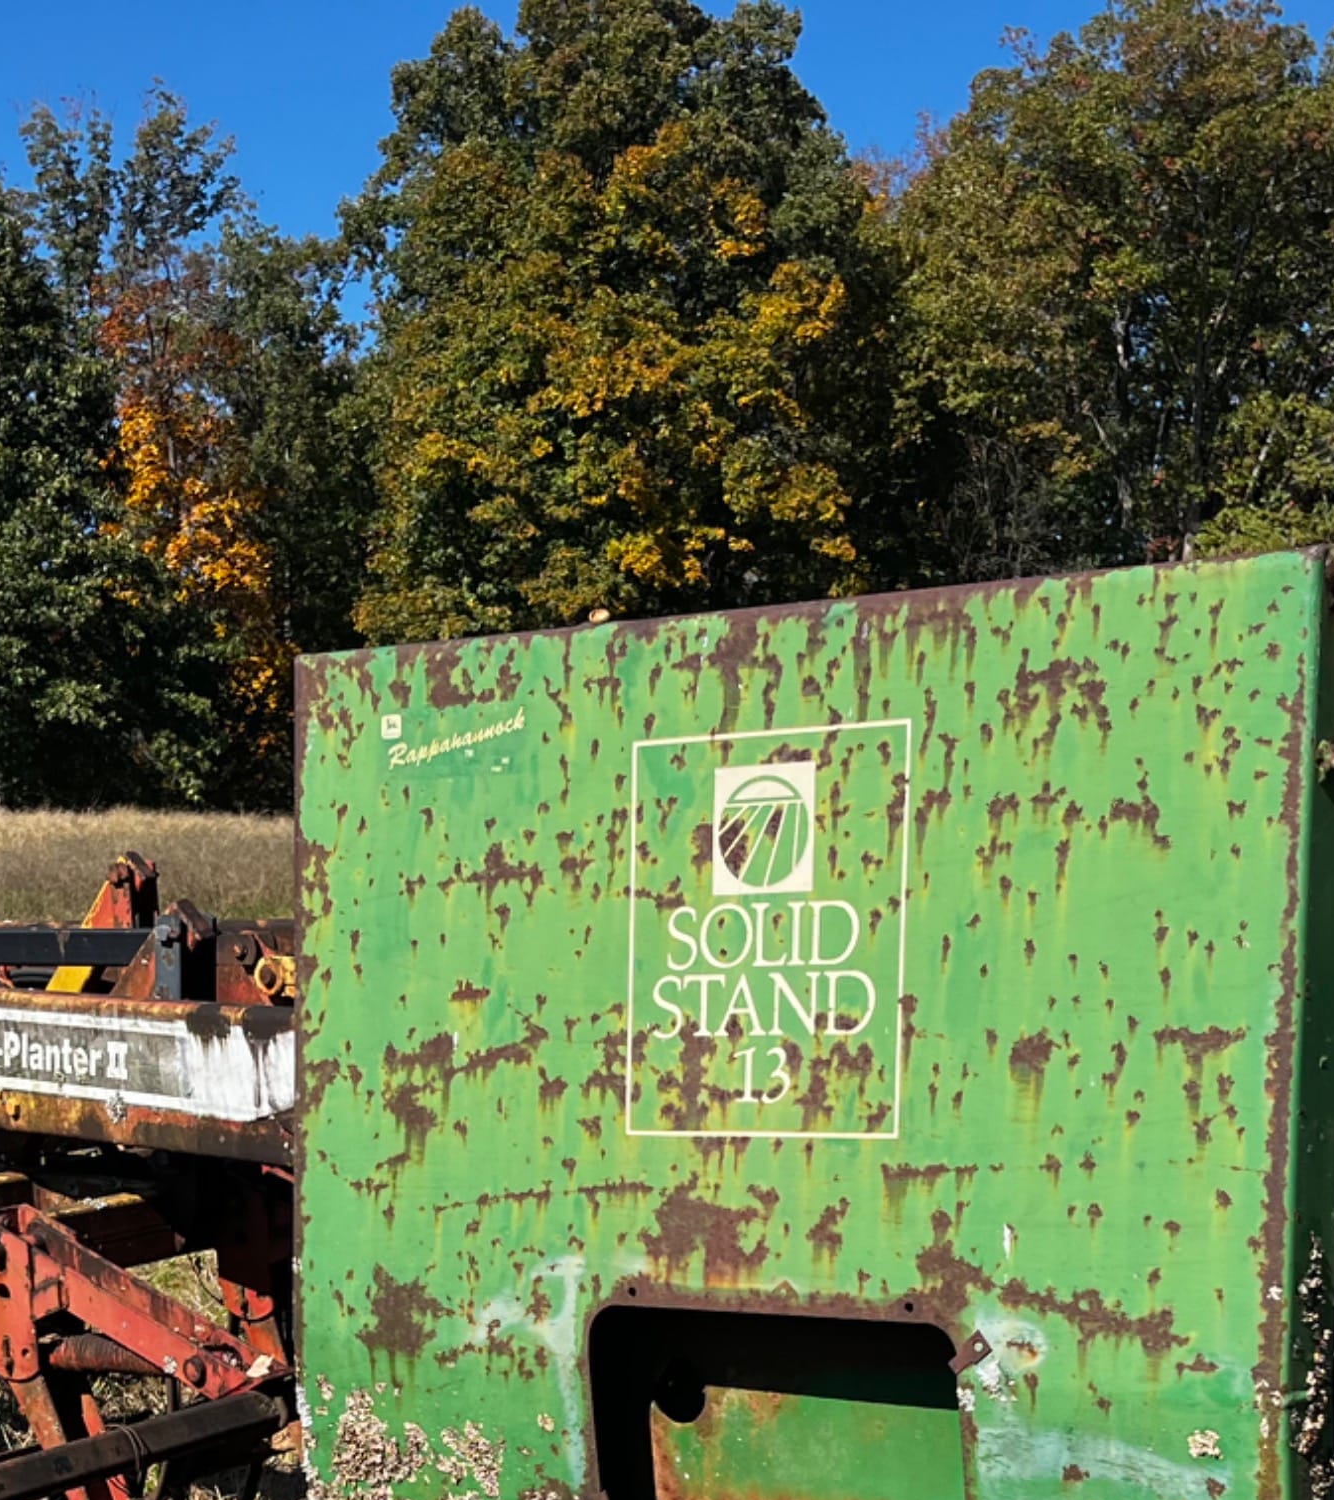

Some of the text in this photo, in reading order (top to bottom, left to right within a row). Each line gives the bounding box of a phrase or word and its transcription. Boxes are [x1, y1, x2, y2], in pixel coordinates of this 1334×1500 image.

[388, 706, 526, 770] Rappahannock
[666, 899, 860, 971] SOLID
[650, 970, 877, 1039] STAND
[731, 1046, 792, 1104] 13
